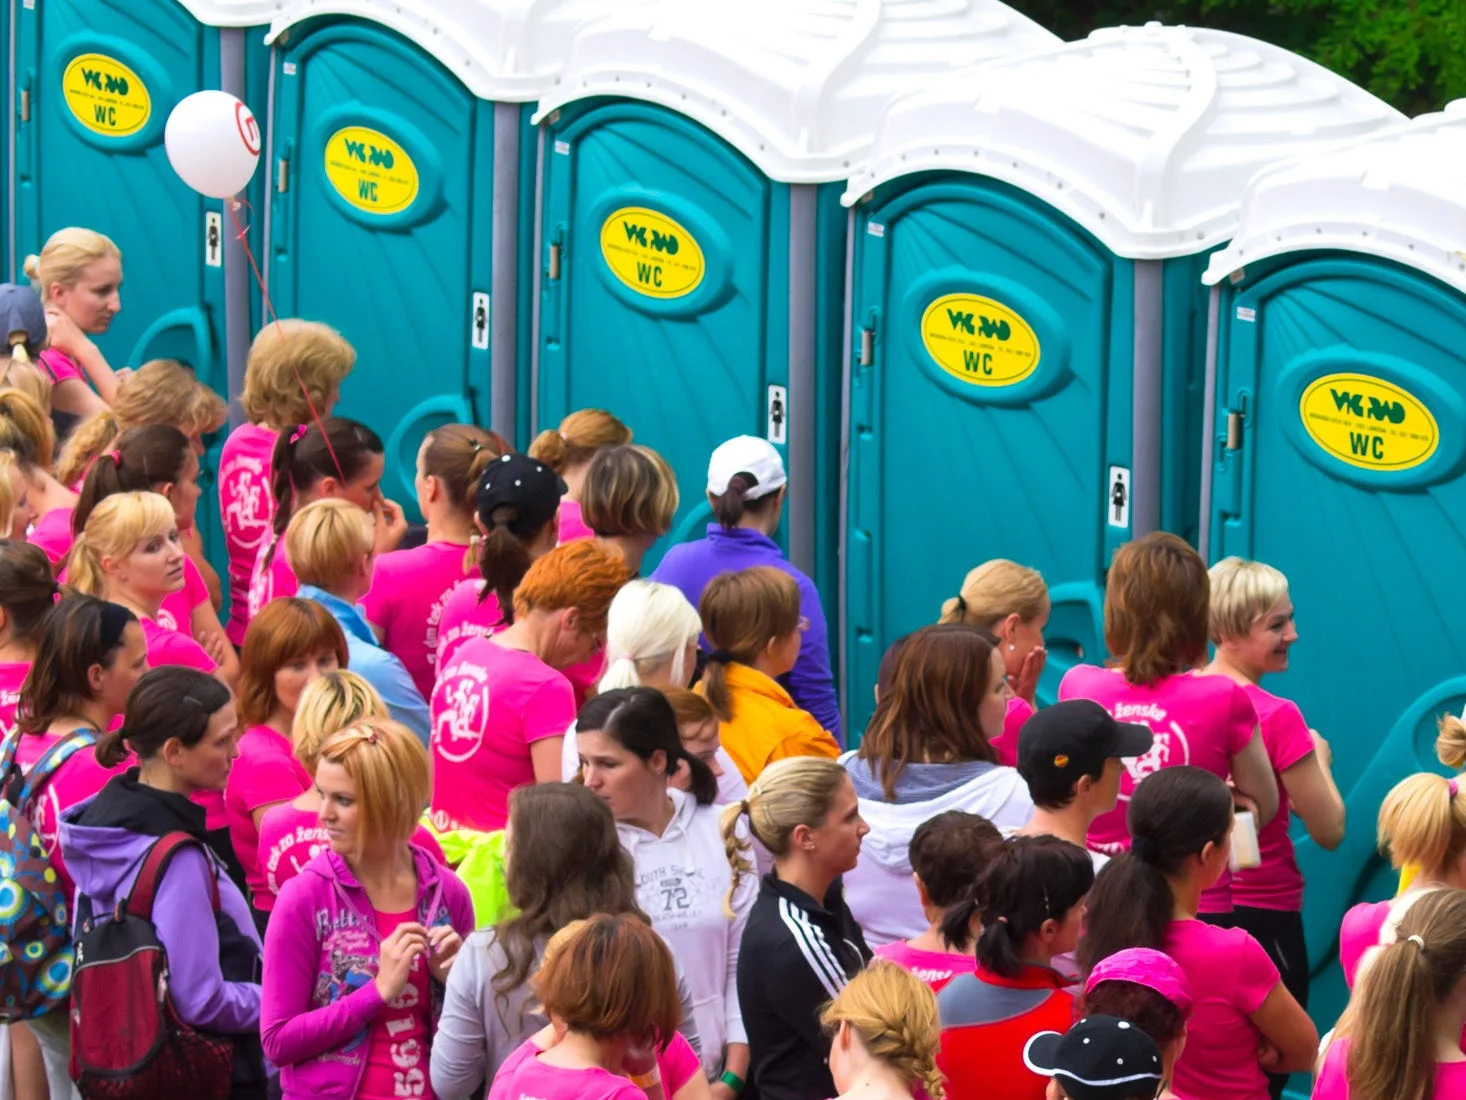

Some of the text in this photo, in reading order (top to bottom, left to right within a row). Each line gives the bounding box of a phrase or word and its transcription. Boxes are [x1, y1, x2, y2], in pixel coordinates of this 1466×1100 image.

[94, 103, 117, 127] WC
[358, 178, 378, 202] WC
[636, 261, 663, 288] WC
[963, 349, 993, 375] WC
[1349, 431, 1384, 460] WC
[296, 826, 329, 843] žens
[661, 887, 690, 911] 72
[316, 908, 369, 941] Bett
